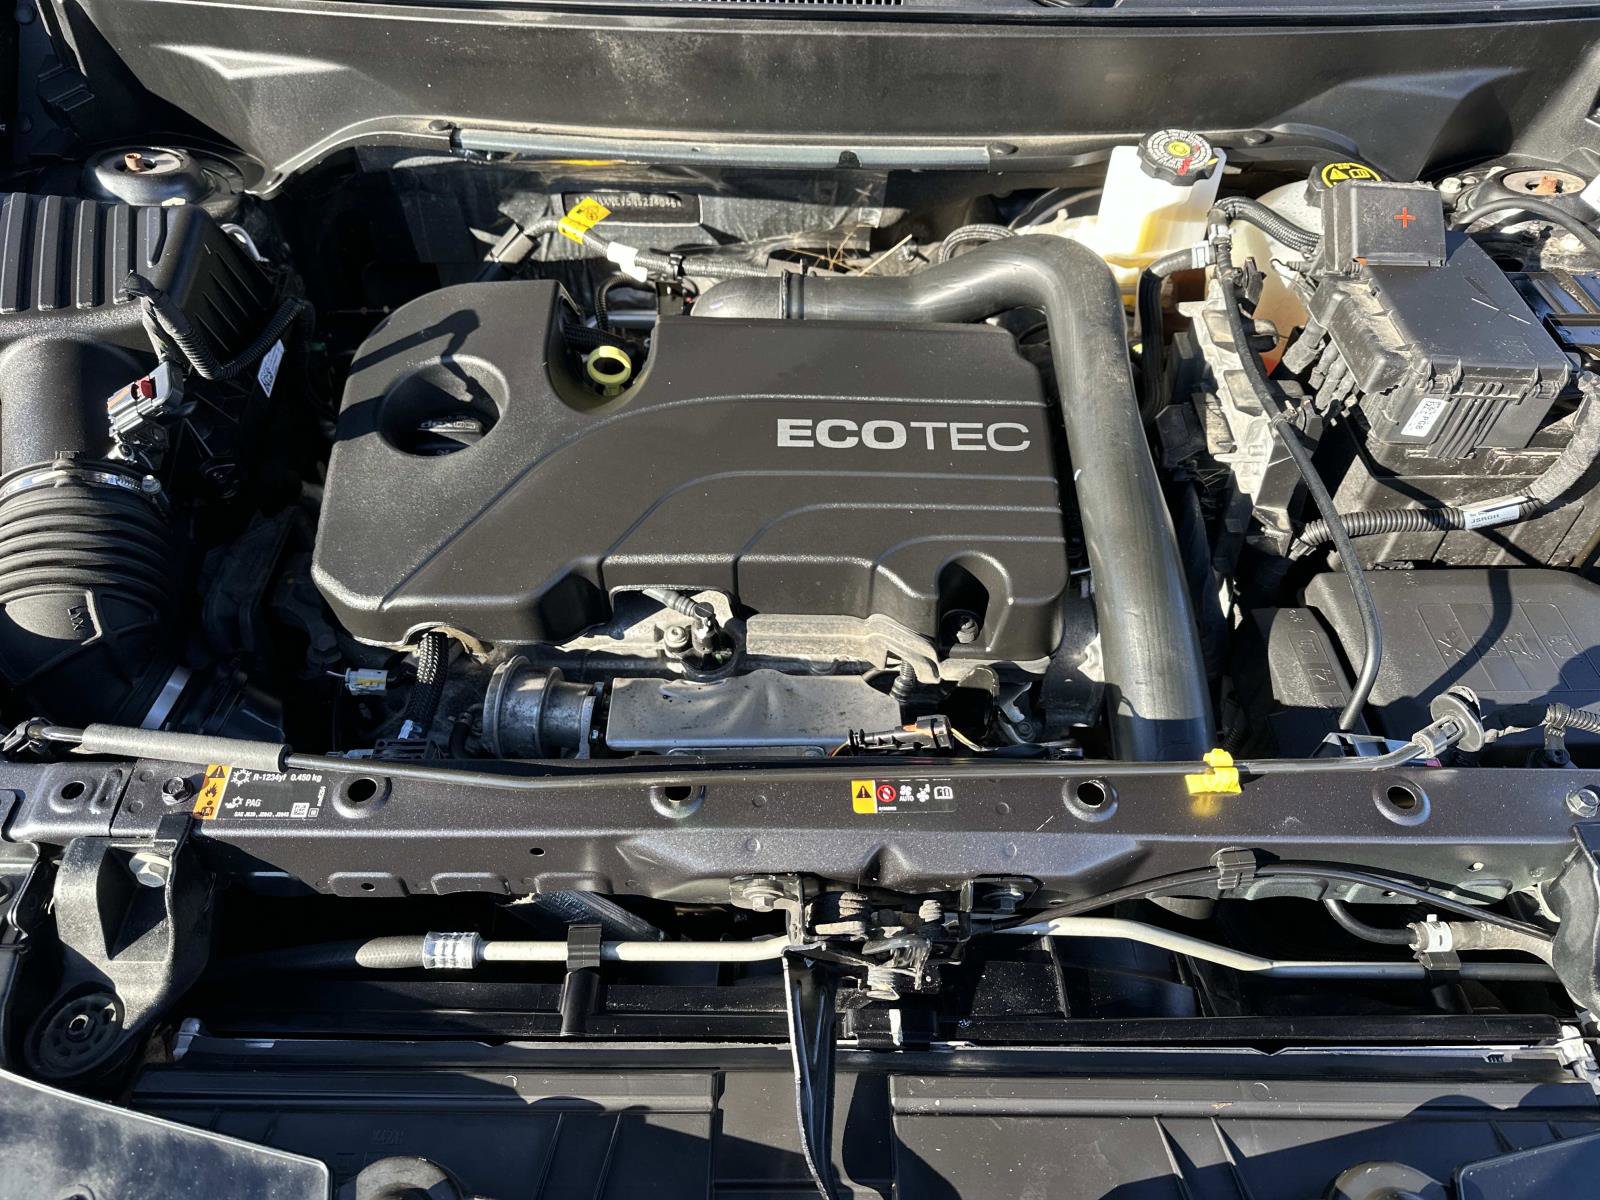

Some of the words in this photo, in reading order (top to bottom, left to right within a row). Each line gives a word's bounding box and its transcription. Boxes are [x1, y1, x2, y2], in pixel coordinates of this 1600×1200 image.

[777, 418, 1031, 452] ECOTEC
[252, 773, 287, 782] R-1234yf
[290, 773, 311, 781] 0.450
[311, 773, 323, 783] kg
[245, 798, 261, 807] PAG
